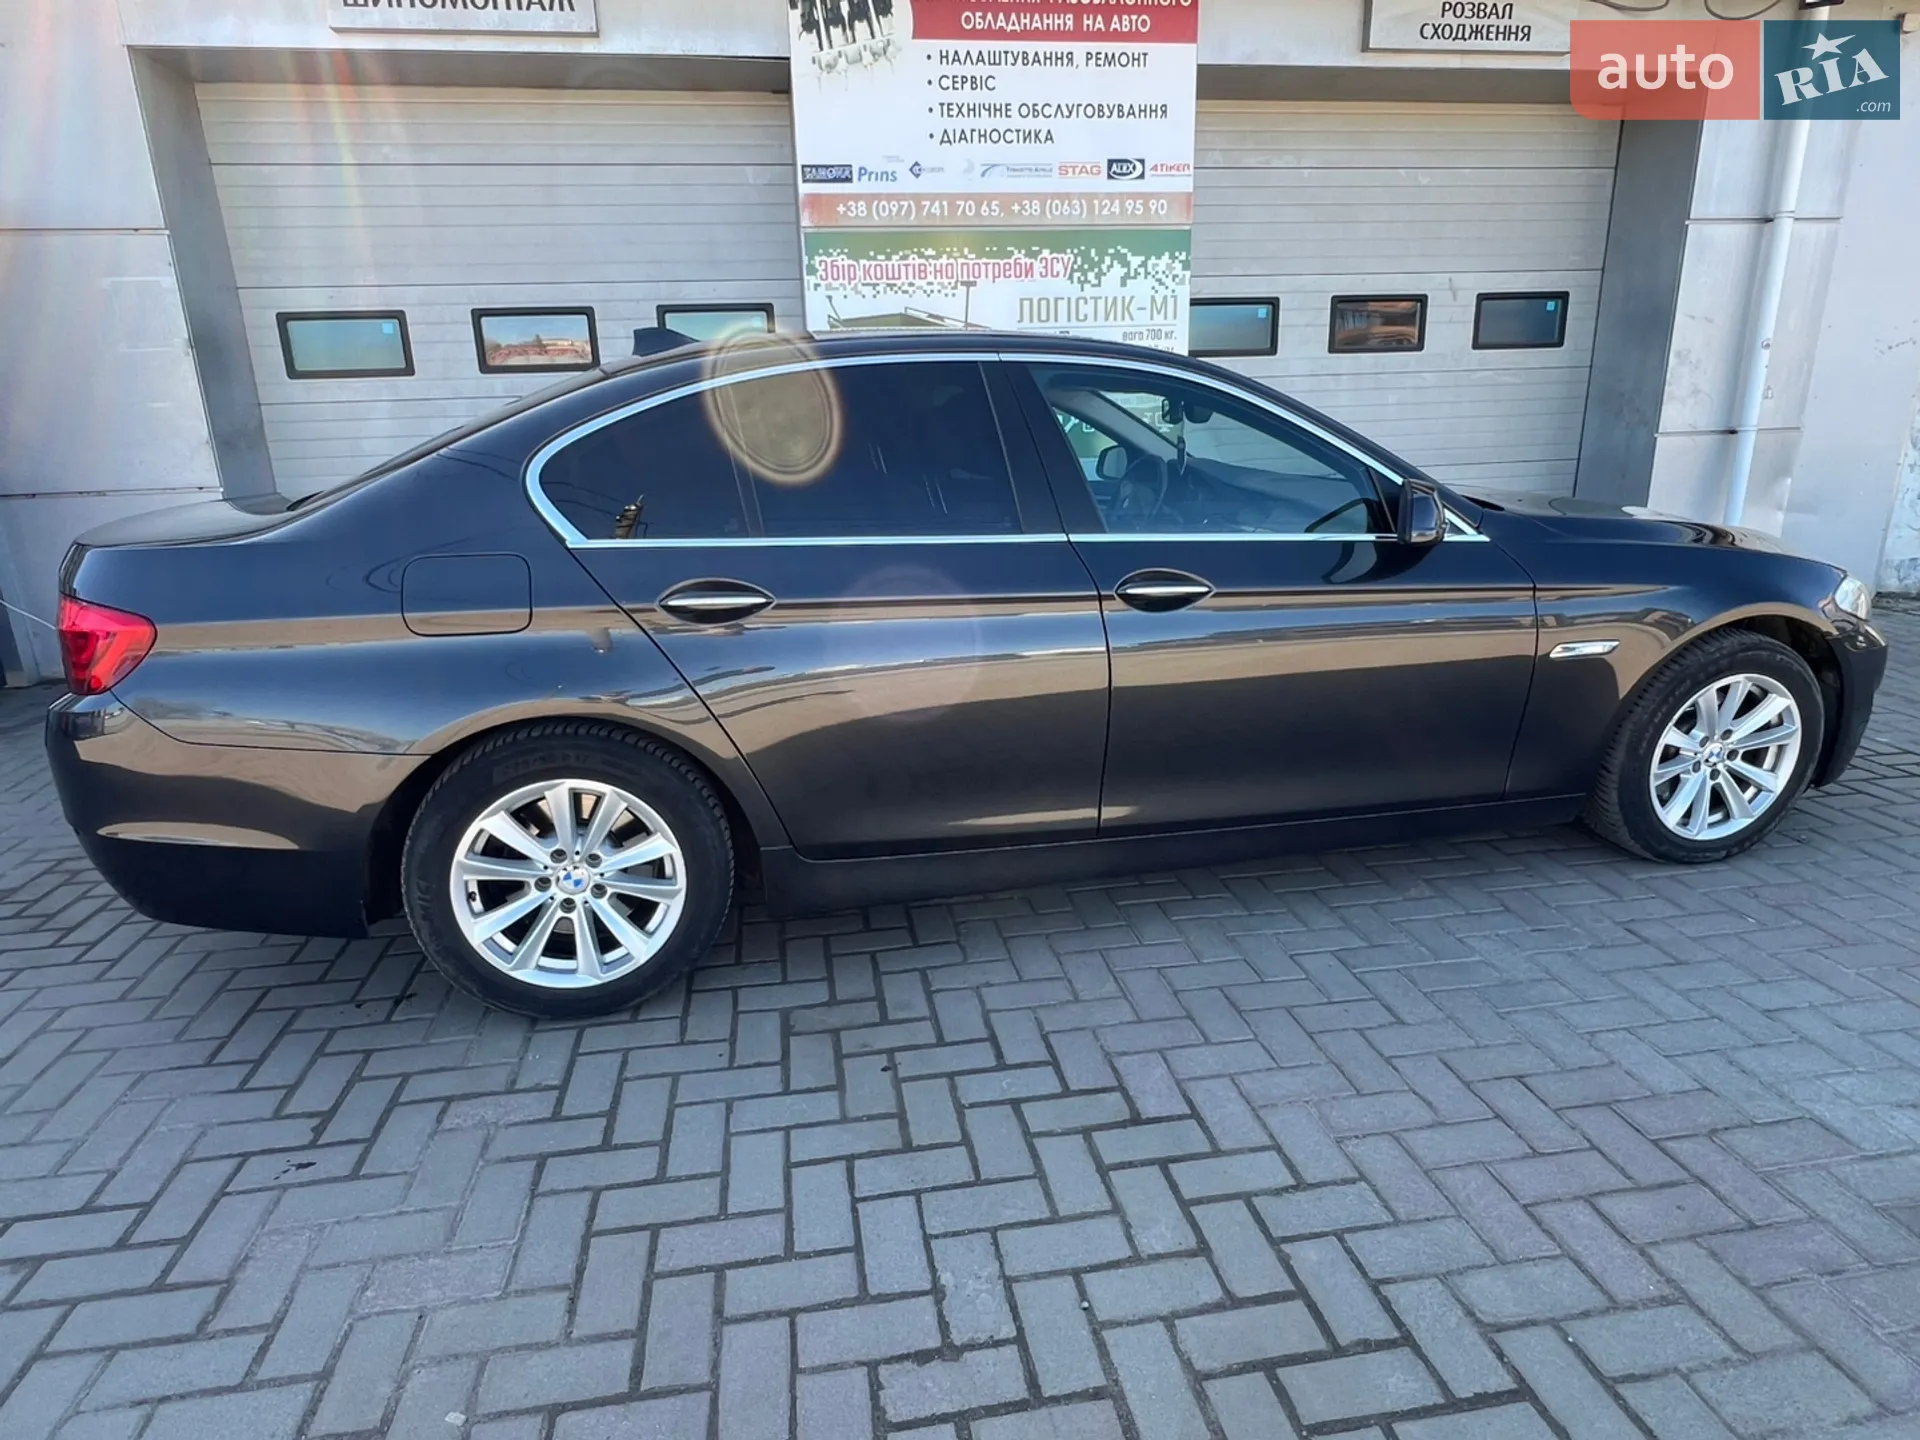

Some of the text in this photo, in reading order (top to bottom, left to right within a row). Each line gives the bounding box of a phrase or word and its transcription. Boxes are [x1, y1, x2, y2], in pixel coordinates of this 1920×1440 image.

[1440, 2, 1513, 19] РОЗВАЛ
[961, 12, 1151, 32] ОБЛАДНАННЯ НА АВТО
[1419, 22, 1532, 43] СХОДЖЕННЯ
[939, 49, 1148, 69] НАЛАШТУВАННЯ, РЕМОНТ
[938, 75, 996, 91] СЕРВІС
[938, 103, 1168, 120] ТЕХНІЧНЕ ОБСЛУГОВУВАННЯ
[939, 129, 1055, 146] ДІАГНОСТИКА
[857, 166, 898, 182] Prins
[1058, 165, 1101, 176] STAG
[836, 200, 1168, 220] +38 (097) 741 70 65, +38 (063) 124 95 90
[818, 259, 857, 284] Збір
[862, 258, 928, 282] коштів
[960, 256, 1034, 283] потреби
[1039, 256, 1073, 278] ЗСУ
[1017, 294, 1179, 324] ЛОГІСТИК-М1
[1146, 329, 1162, 341] 700
